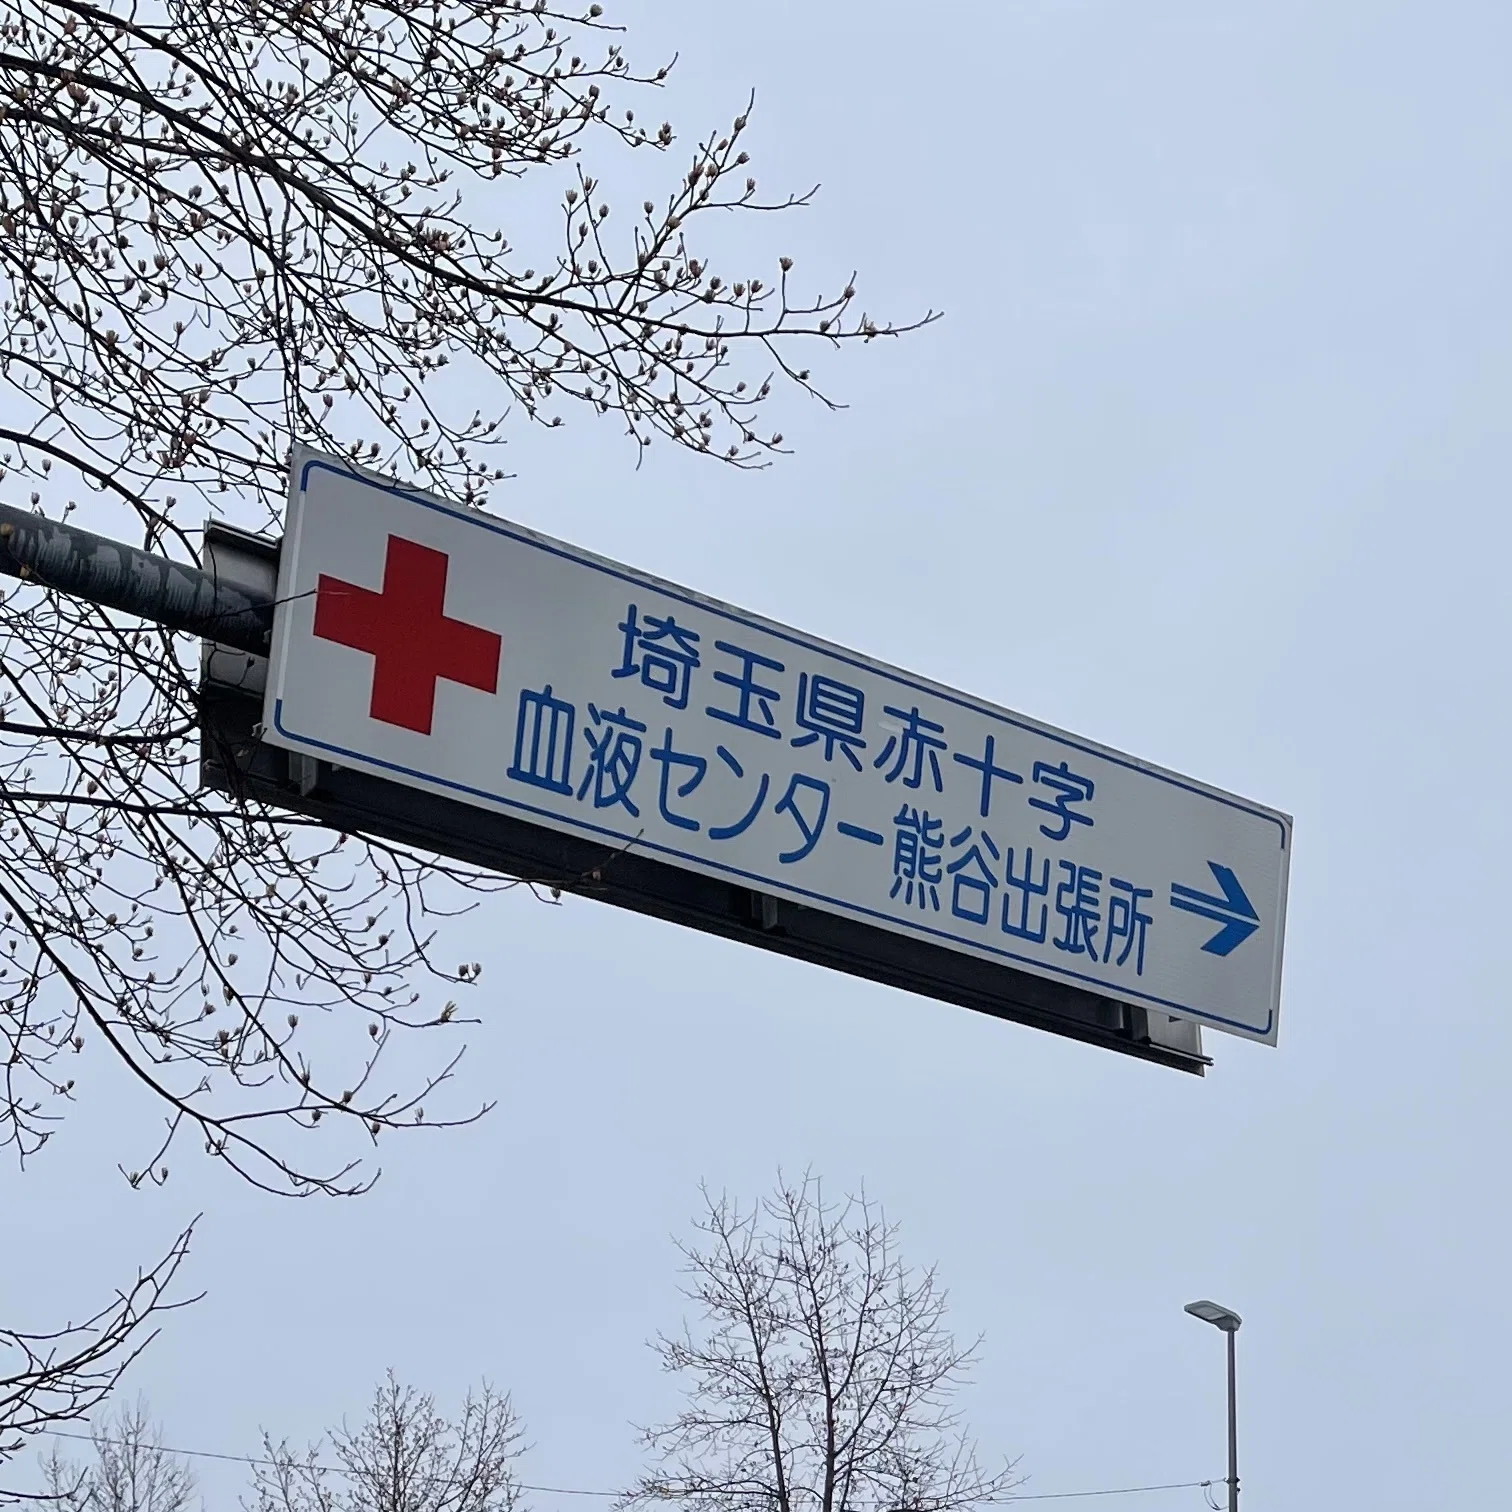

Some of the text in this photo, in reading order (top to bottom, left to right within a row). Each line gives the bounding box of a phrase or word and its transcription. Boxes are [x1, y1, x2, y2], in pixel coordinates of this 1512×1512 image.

[506, 684, 1154, 977] 血液センター熊谷出張所
[611, 603, 1095, 841] 埼玉県赤十字
